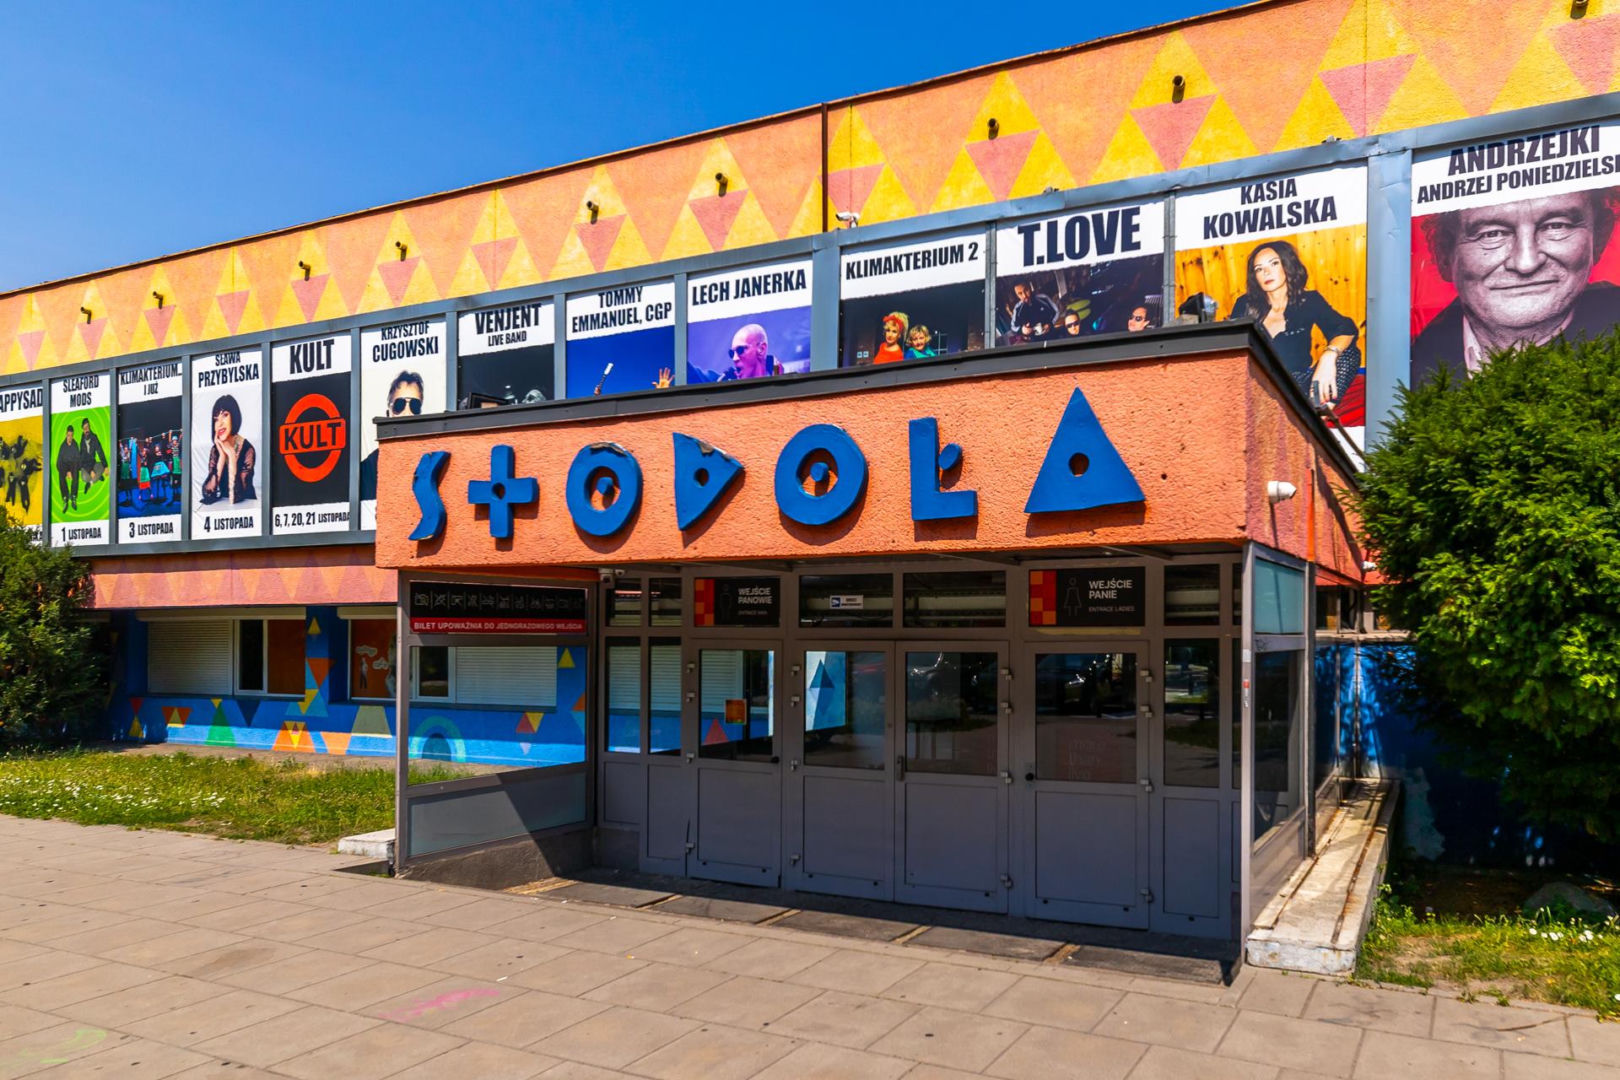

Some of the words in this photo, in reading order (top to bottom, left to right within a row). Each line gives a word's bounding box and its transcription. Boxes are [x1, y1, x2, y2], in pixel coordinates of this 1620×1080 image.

[1448, 125, 1600, 176] ANDRZEJKI
[1240, 178, 1298, 205] KASIA
[1417, 173, 1493, 204] ANDRZEJ
[1203, 196, 1338, 240] KOWALSKA
[1017, 207, 1141, 267] T.LOVE
[845, 245, 965, 280] KLIMAKTERIUM
[968, 242, 979, 261] 2
[598, 286, 643, 309] TOMMY
[692, 281, 730, 306] LECH
[734, 269, 806, 300] JANERKA
[475, 303, 542, 335] VENJENT
[572, 311, 643, 334] EMMANUEL,
[645, 302, 672, 323] CGP
[381, 321, 430, 341] KRZYSZTOF
[488, 334, 503, 347] LIVE
[505, 331, 528, 345] BAND
[215, 351, 241, 367] SŁAWA
[289, 339, 335, 374] KULT
[372, 336, 439, 363] CUGOWSKI
[62, 375, 100, 393] SLEAFORD
[198, 363, 260, 388] PRZYBYLSKA
[70, 392, 92, 408] MODS
[284, 422, 342, 452] KULT
[204, 516, 211, 533] 4
[214, 516, 254, 530] LISTOPADA
[306, 511, 316, 525] 21
[61, 527, 66, 542] 1
[68, 528, 102, 539] LISTOPADA
[129, 522, 135, 538] 3
[138, 523, 174, 536] LISTOPADA
[738, 586, 771, 596] WEJŚCIE
[1089, 578, 1132, 589] WEJŚCIE
[738, 595, 772, 605] PANOWIE
[1089, 590, 1117, 599] PANIE
[414, 622, 436, 630] BILET
[438, 622, 482, 630] UPOWAŻNIA
